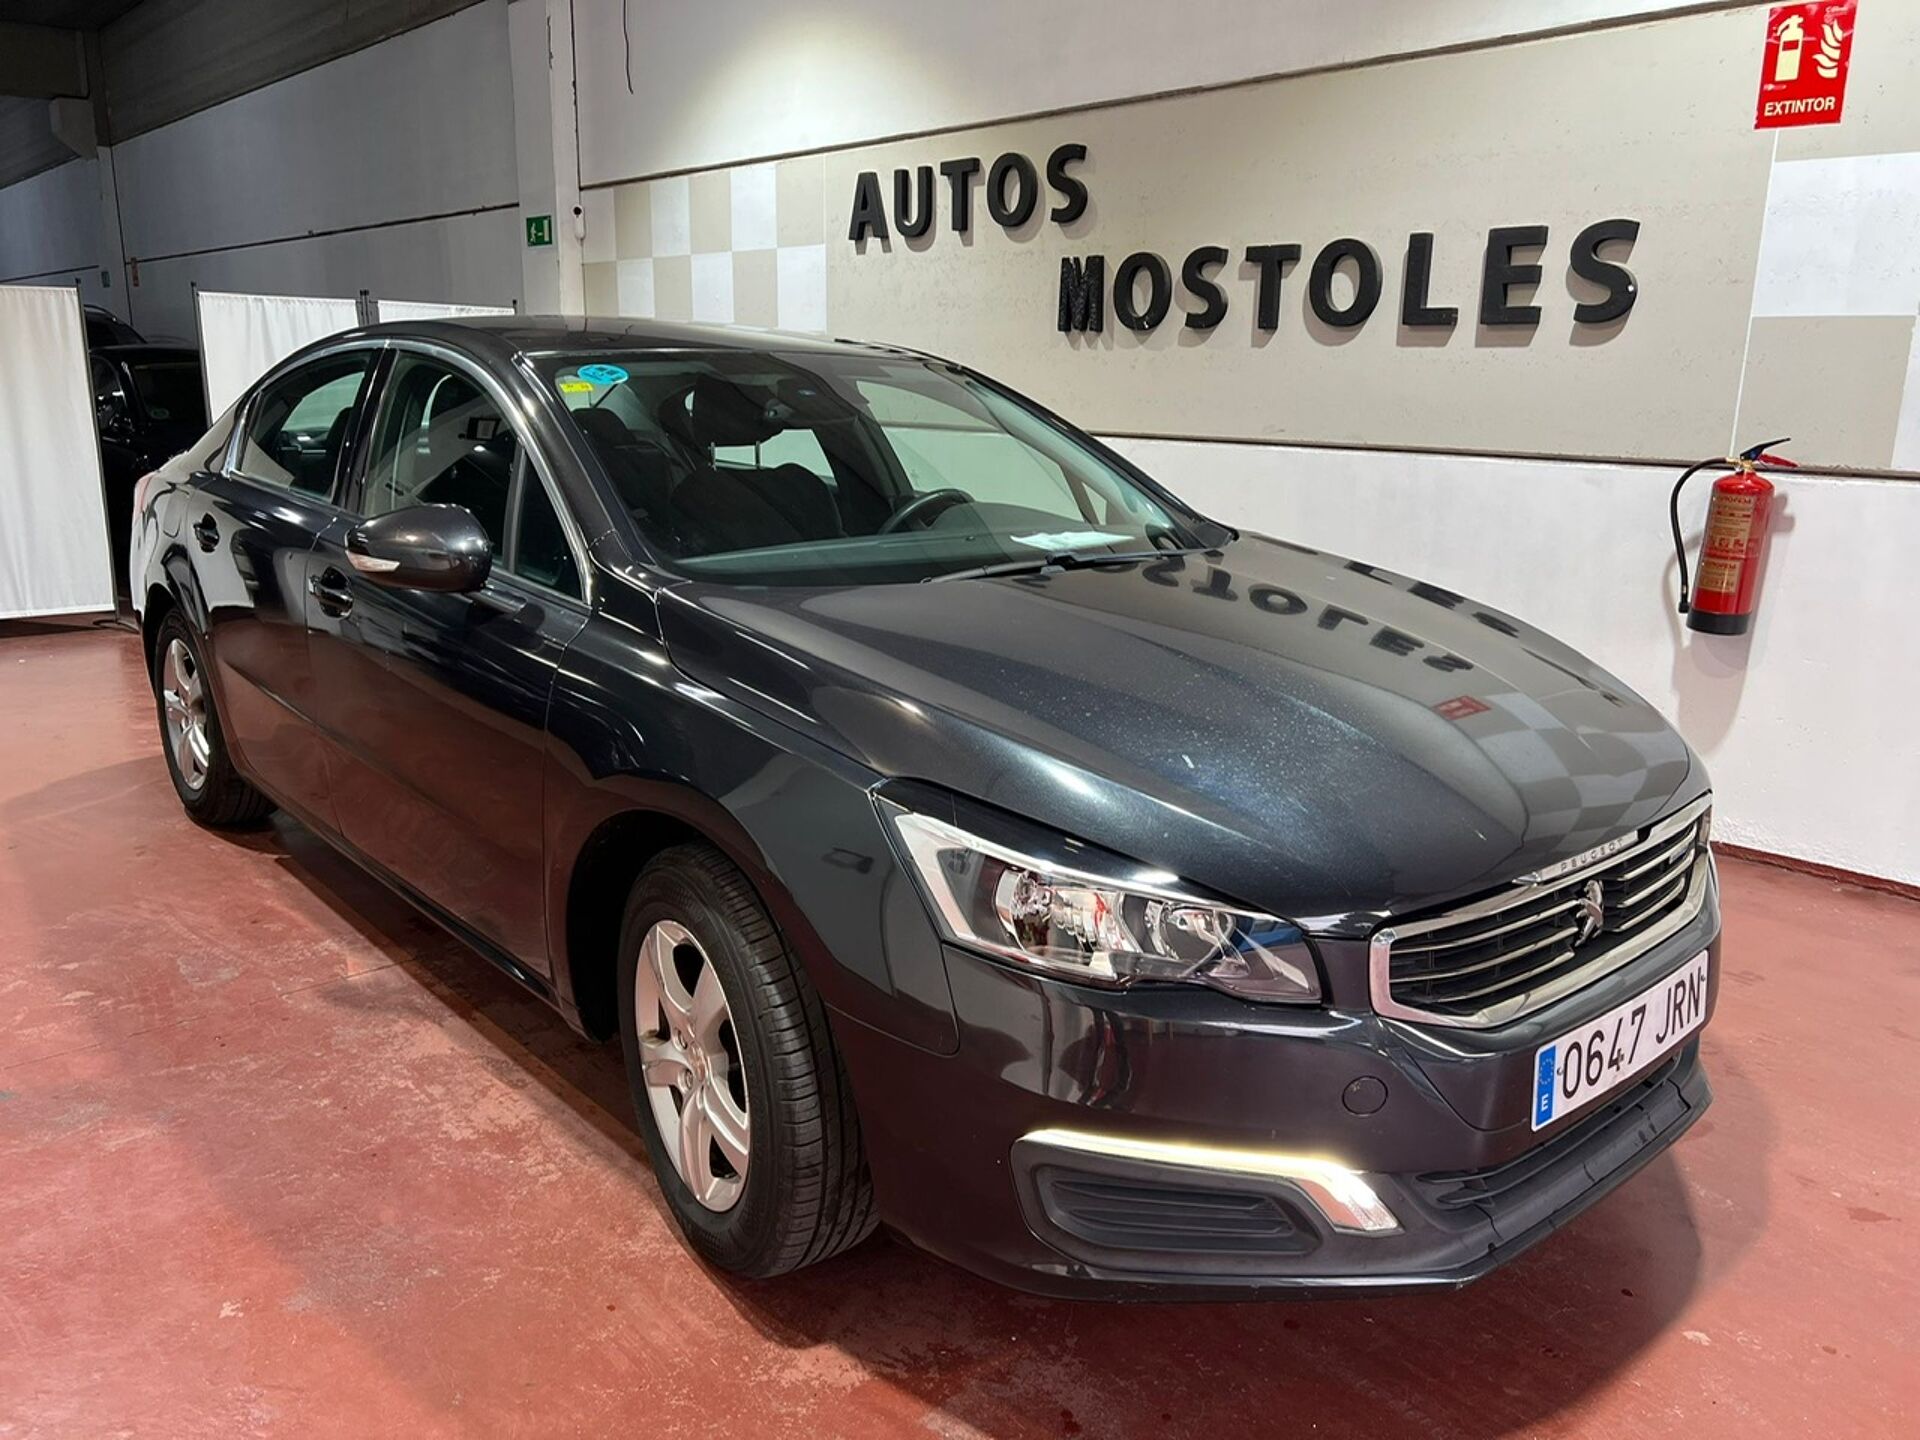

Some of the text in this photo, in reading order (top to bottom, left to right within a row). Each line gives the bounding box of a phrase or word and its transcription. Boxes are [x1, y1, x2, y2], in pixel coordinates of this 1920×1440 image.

[1764, 96, 1836, 117] EXTINTOR
[848, 143, 1088, 242] AUTOS
[1057, 218, 1640, 332] MOSTOLES
[1561, 1004, 1647, 1099] 0647
[1655, 966, 1702, 1044] JRN
